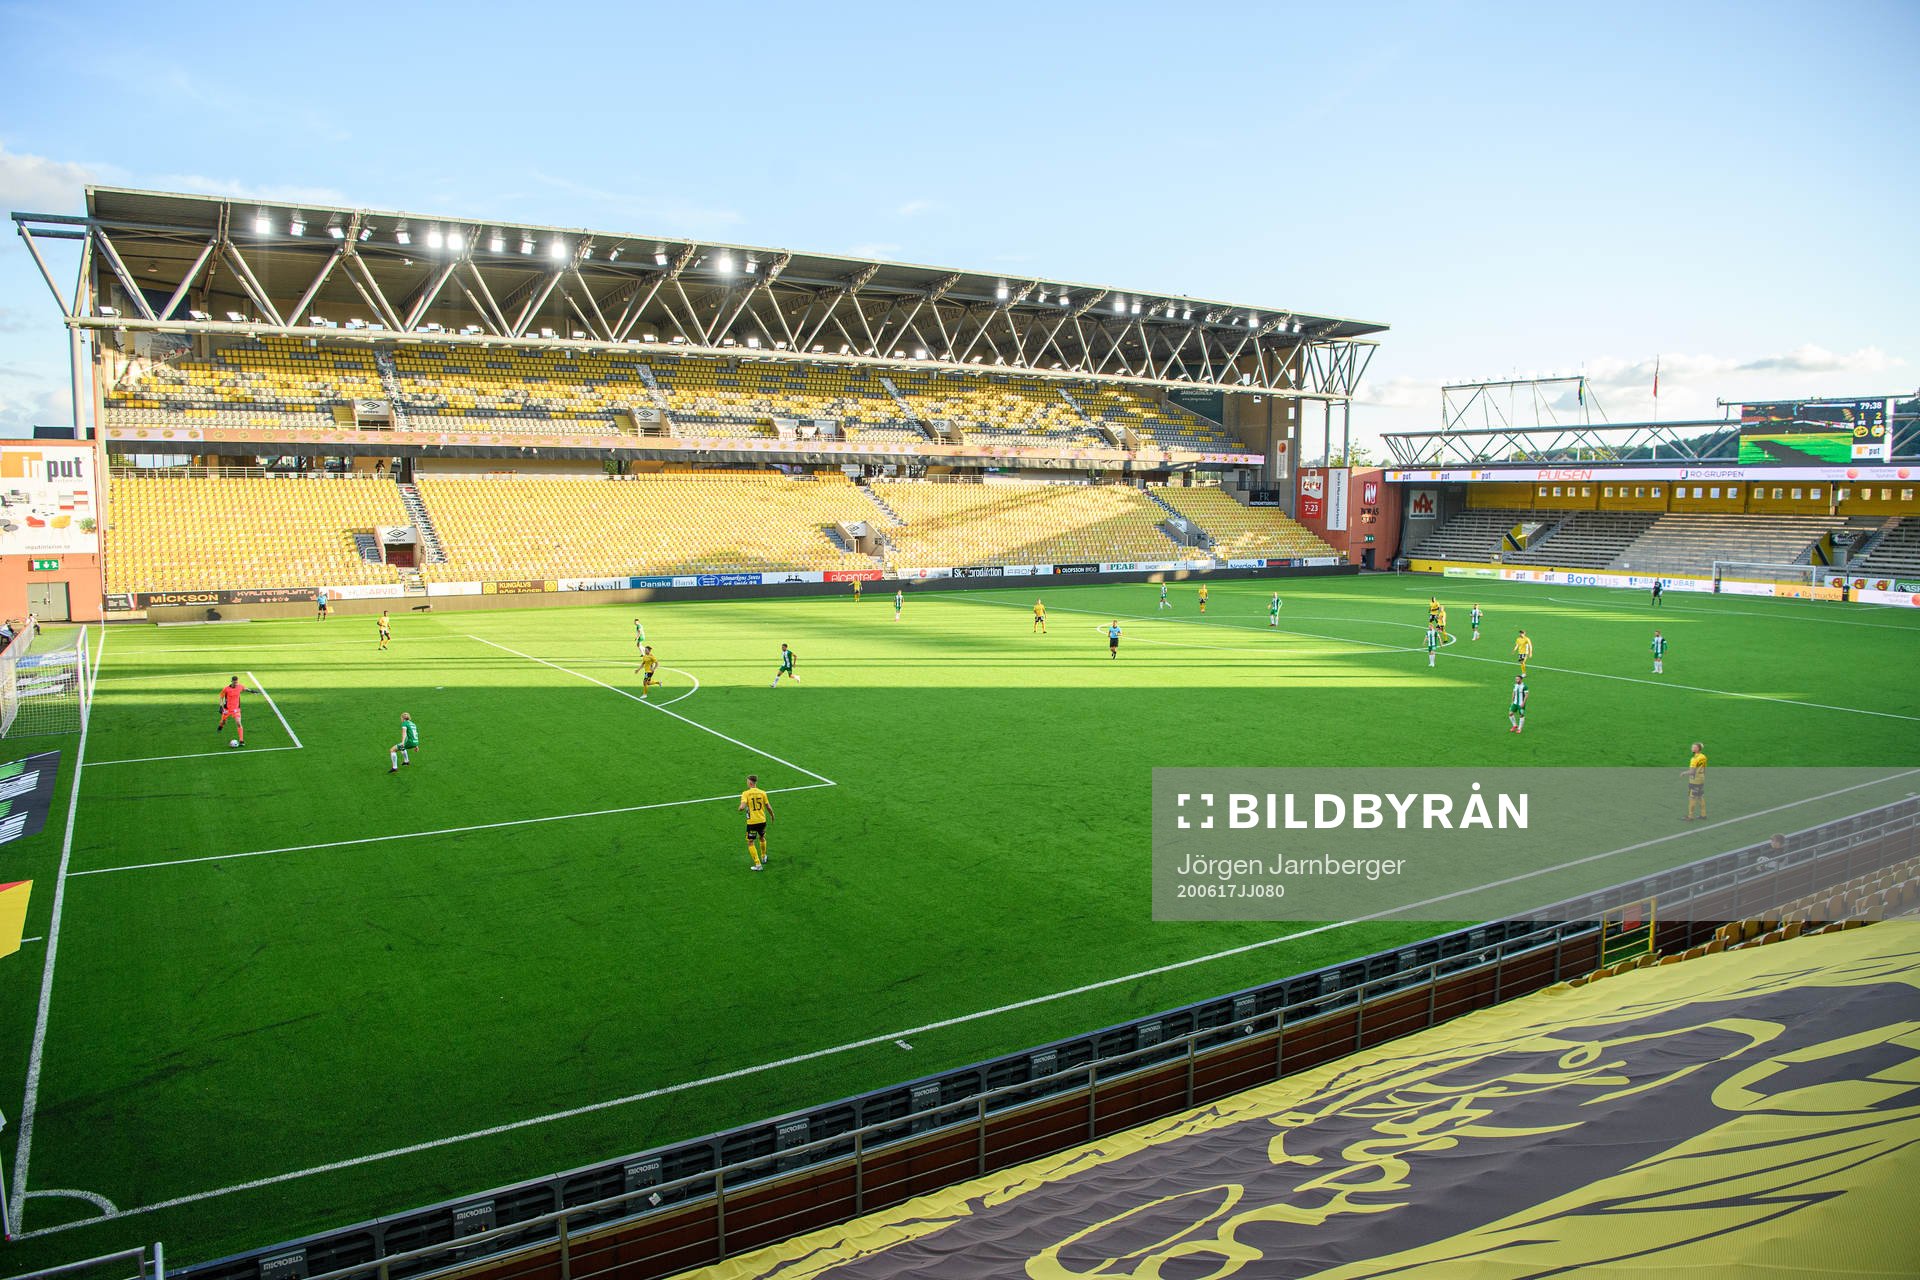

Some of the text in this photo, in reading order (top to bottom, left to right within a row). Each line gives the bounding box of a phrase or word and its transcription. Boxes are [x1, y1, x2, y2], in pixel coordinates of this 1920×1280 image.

[1860, 402, 1882, 410] 79:38
[1860, 412, 1882, 420] 1 2
[1537, 469, 1592, 480] PULSEN
[1304, 504, 1319, 512] 7-23
[1110, 563, 1135, 571] PEAB
[640, 579, 671, 588] Danske
[751, 797, 763, 811] 15
